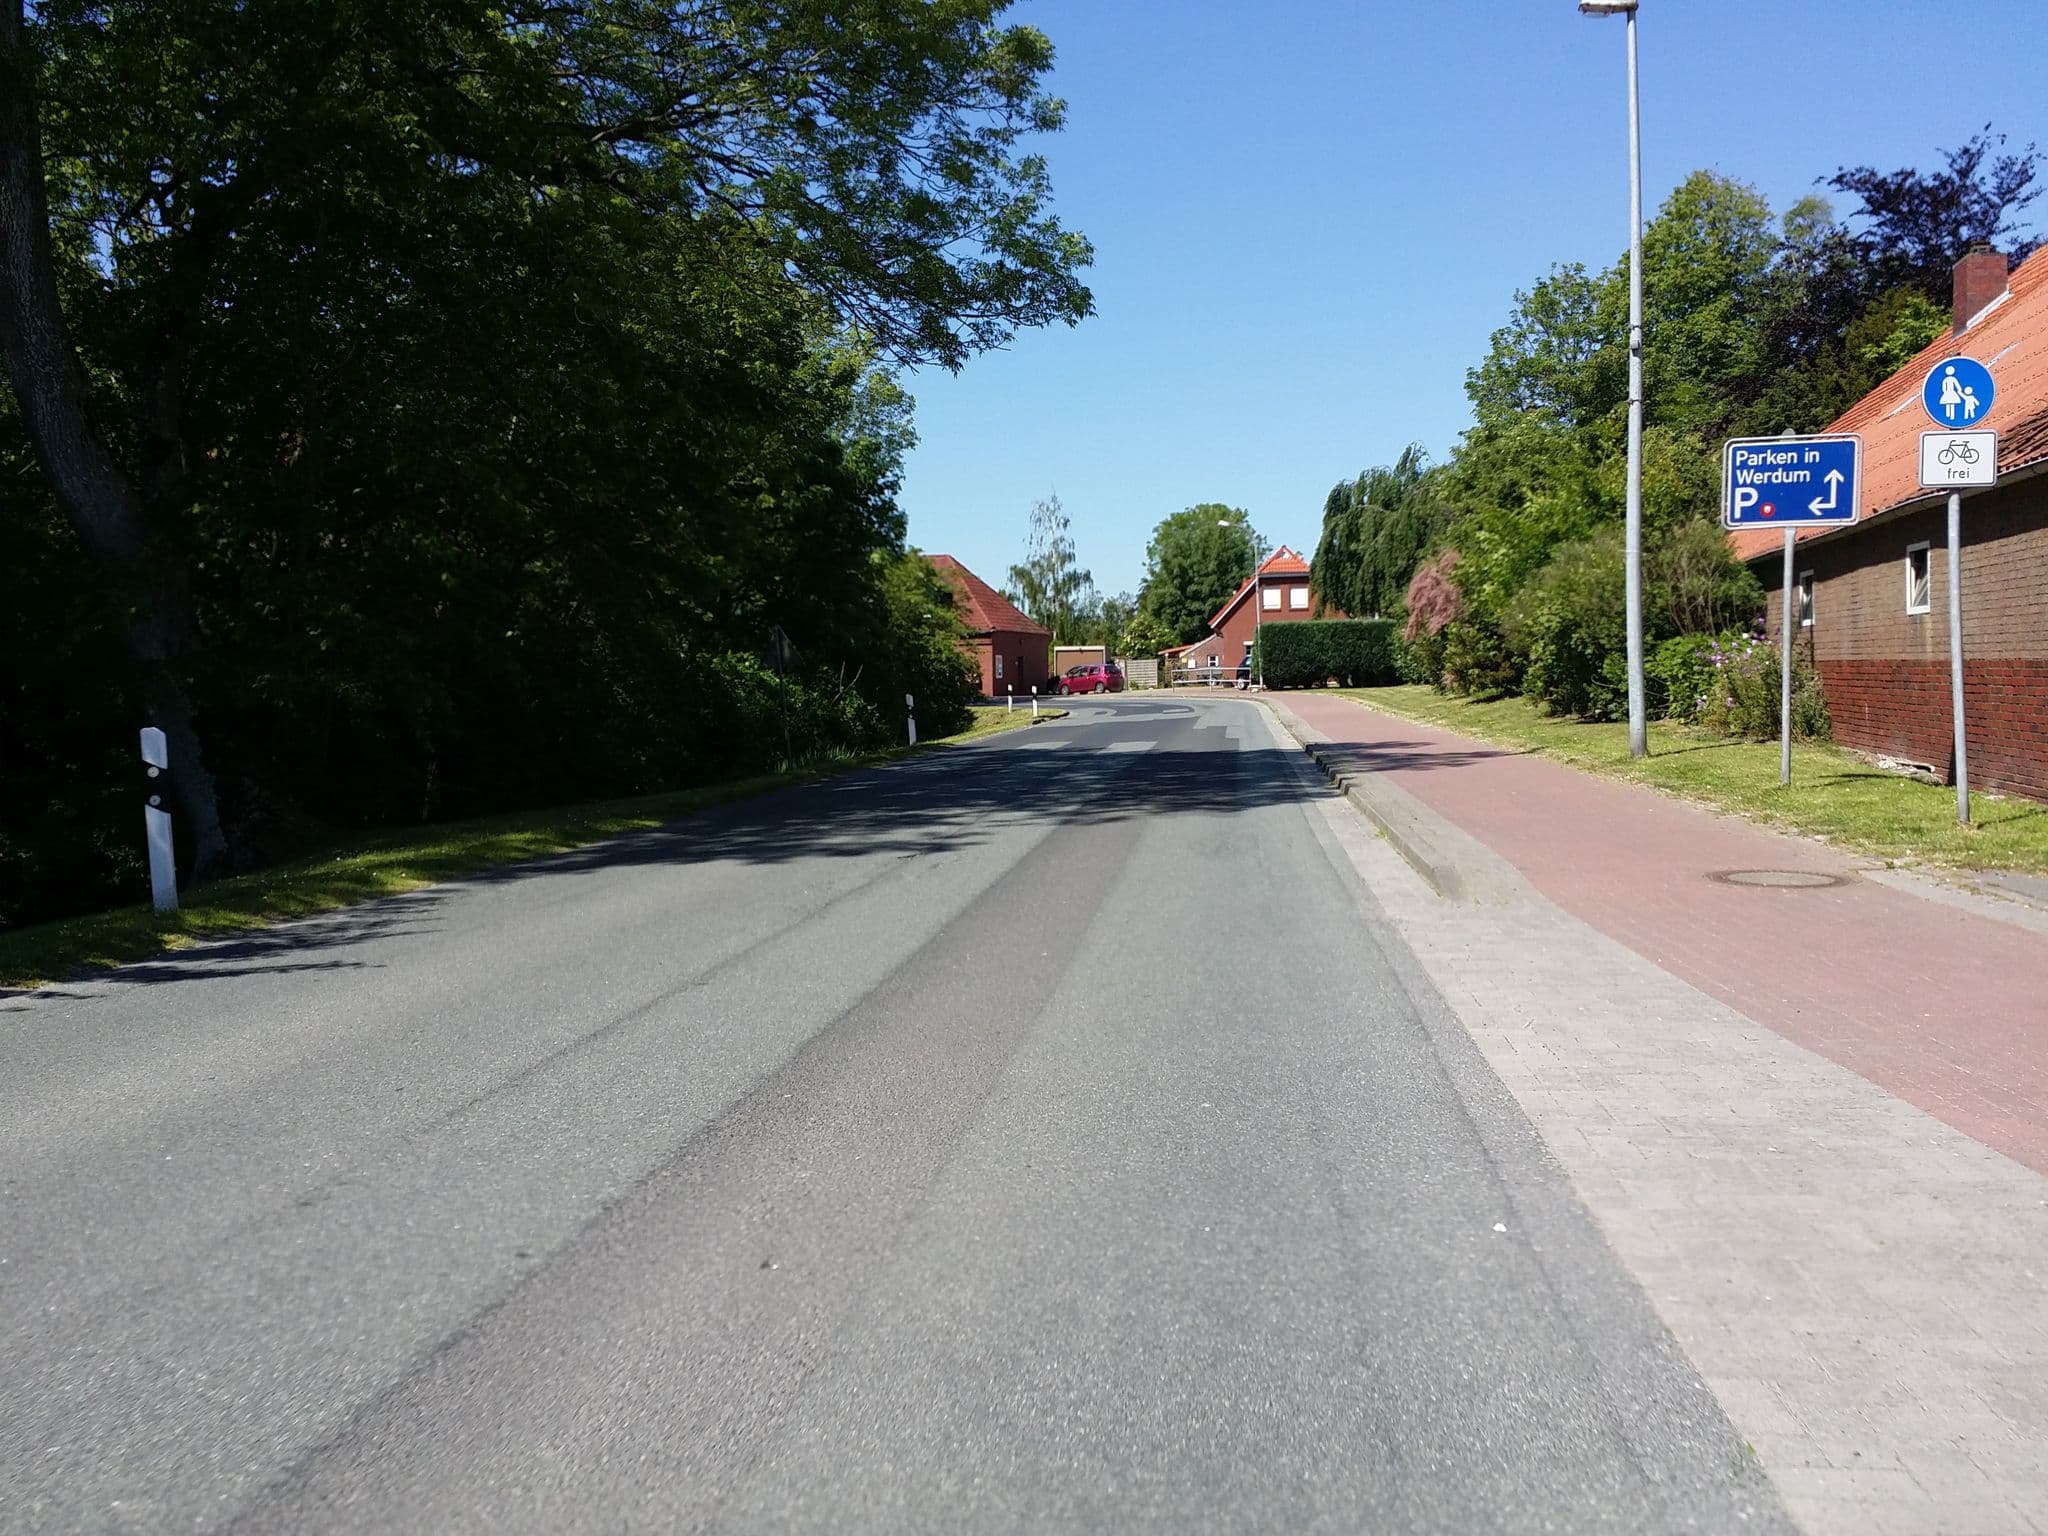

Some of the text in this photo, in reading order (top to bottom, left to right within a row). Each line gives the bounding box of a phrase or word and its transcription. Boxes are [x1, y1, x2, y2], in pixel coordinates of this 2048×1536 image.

[1735, 447, 1820, 467] Parken in
[1736, 467, 1810, 485] Werdum
[1947, 467, 1970, 480] frei
[1734, 487, 1759, 519] P
